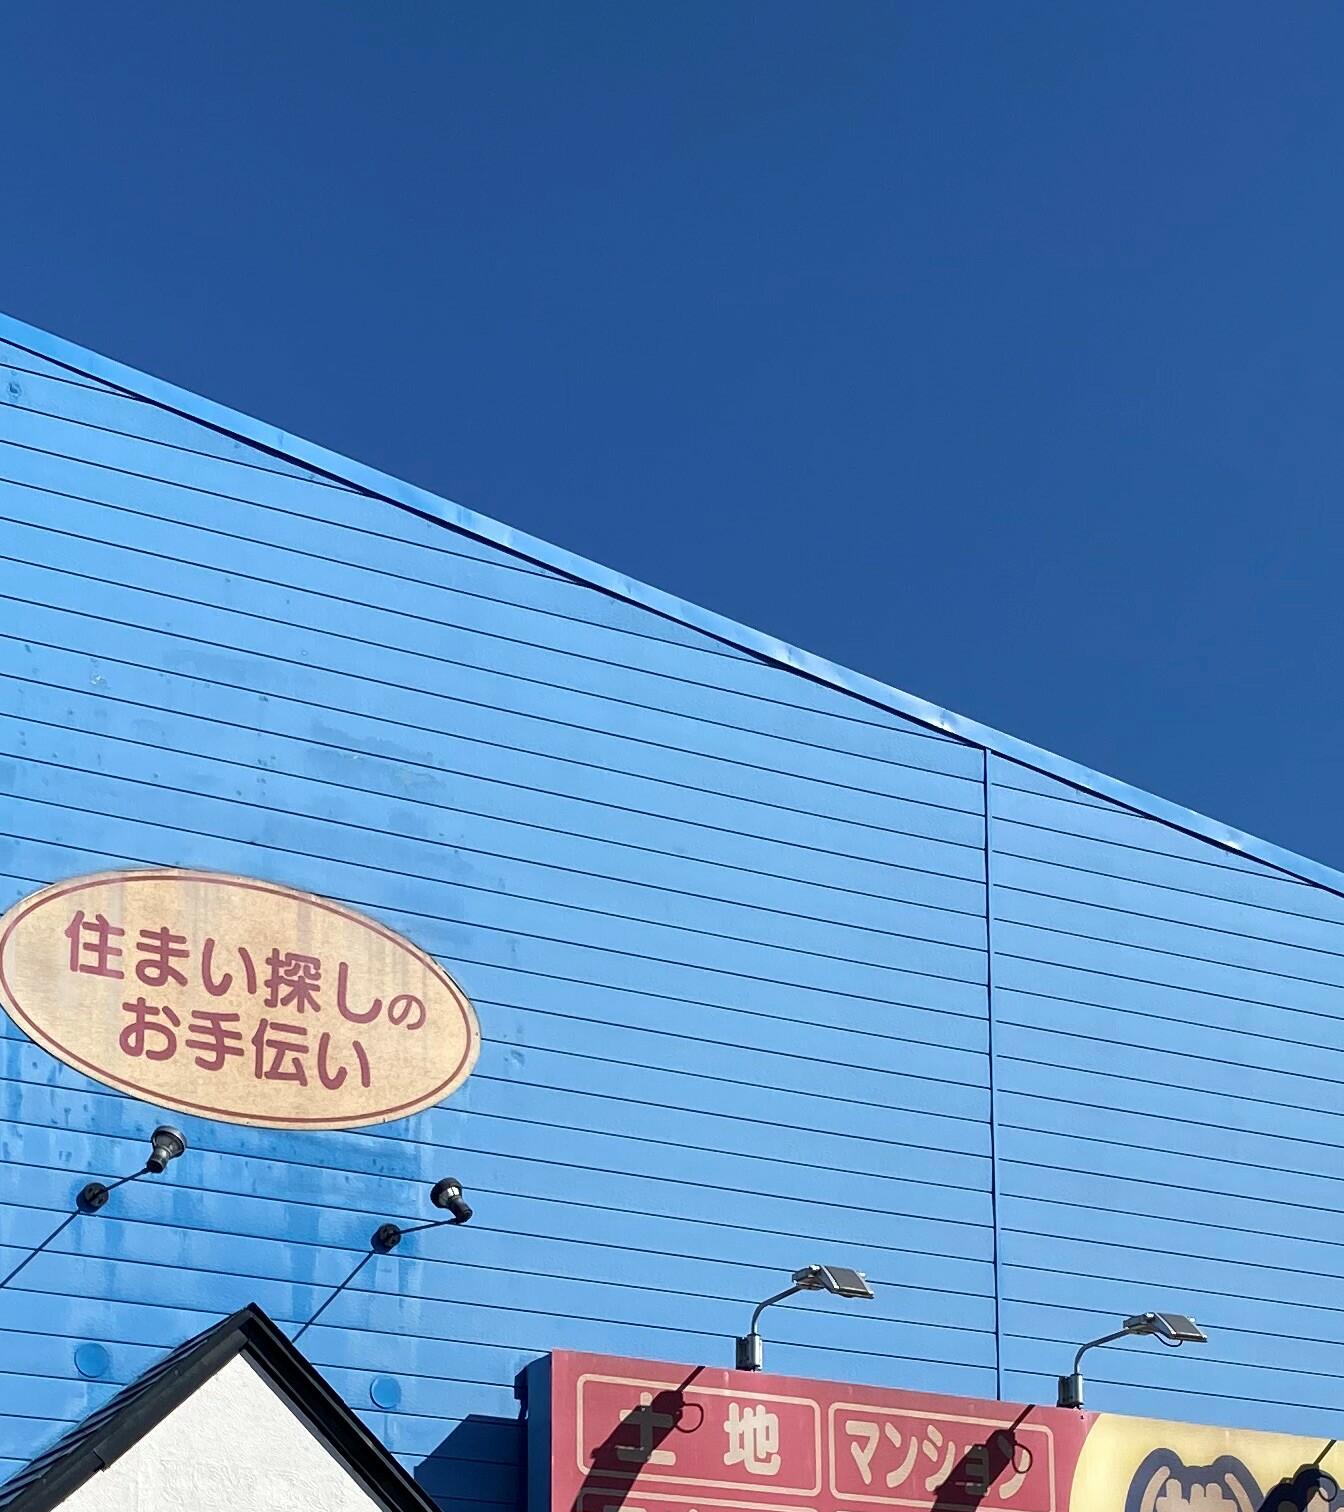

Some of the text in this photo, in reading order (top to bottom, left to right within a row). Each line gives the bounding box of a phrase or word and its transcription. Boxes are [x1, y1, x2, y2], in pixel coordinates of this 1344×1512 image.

[64, 909, 427, 1031] 住まい探しの
[118, 996, 372, 1090] お手伝い
[611, 1391, 782, 1477] 土地
[844, 1419, 1033, 1500] マンション
